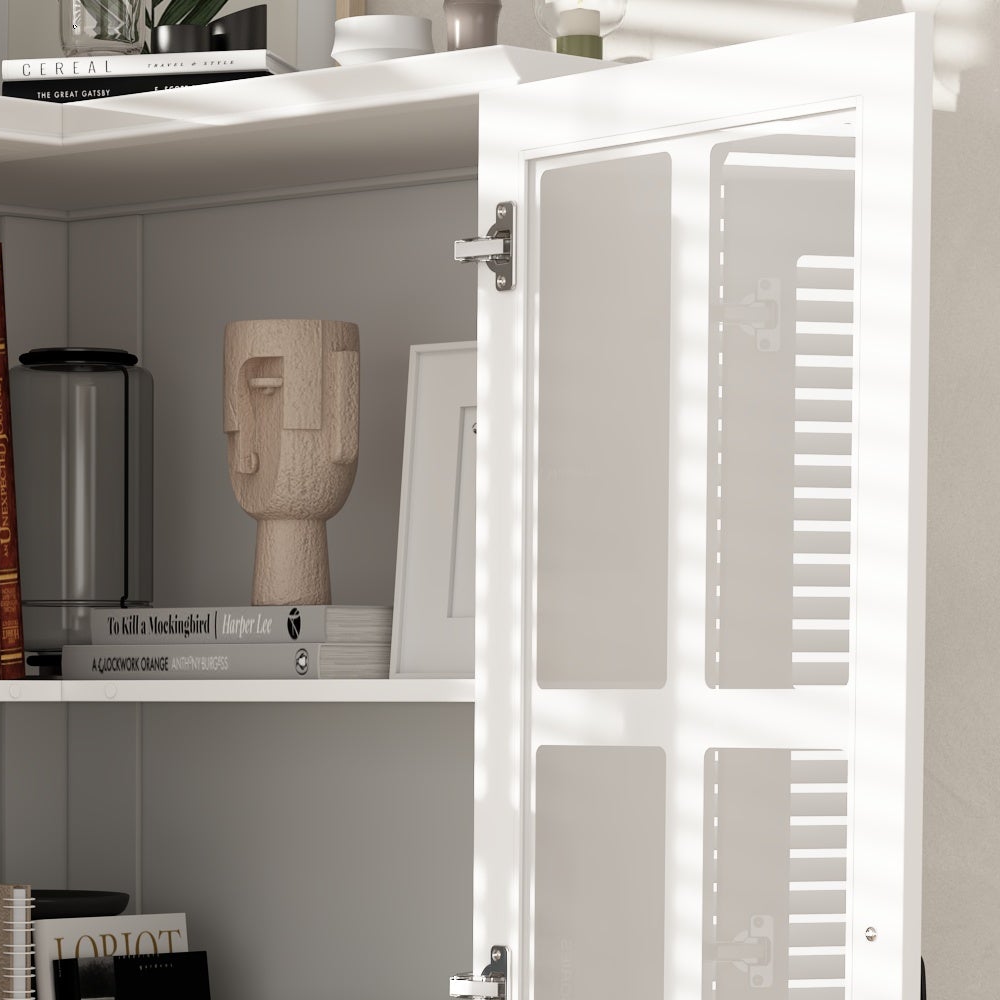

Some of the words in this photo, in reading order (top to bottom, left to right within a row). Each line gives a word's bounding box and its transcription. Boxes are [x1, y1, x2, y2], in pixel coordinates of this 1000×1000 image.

[22, 60, 112, 77] CEREAL
[37, 91, 51, 99] THE
[54, 90, 78, 99] GREAT
[81, 88, 111, 97] GATSBY
[107, 616, 119, 635] To
[122, 615, 139, 635] Kill
[140, 620, 146, 634] a
[149, 613, 210, 638] Mockingbird
[221, 613, 255, 637] Harper
[256, 615, 273, 635] Lee
[91, 657, 97, 671] A
[140, 657, 169, 671] ORANGE
